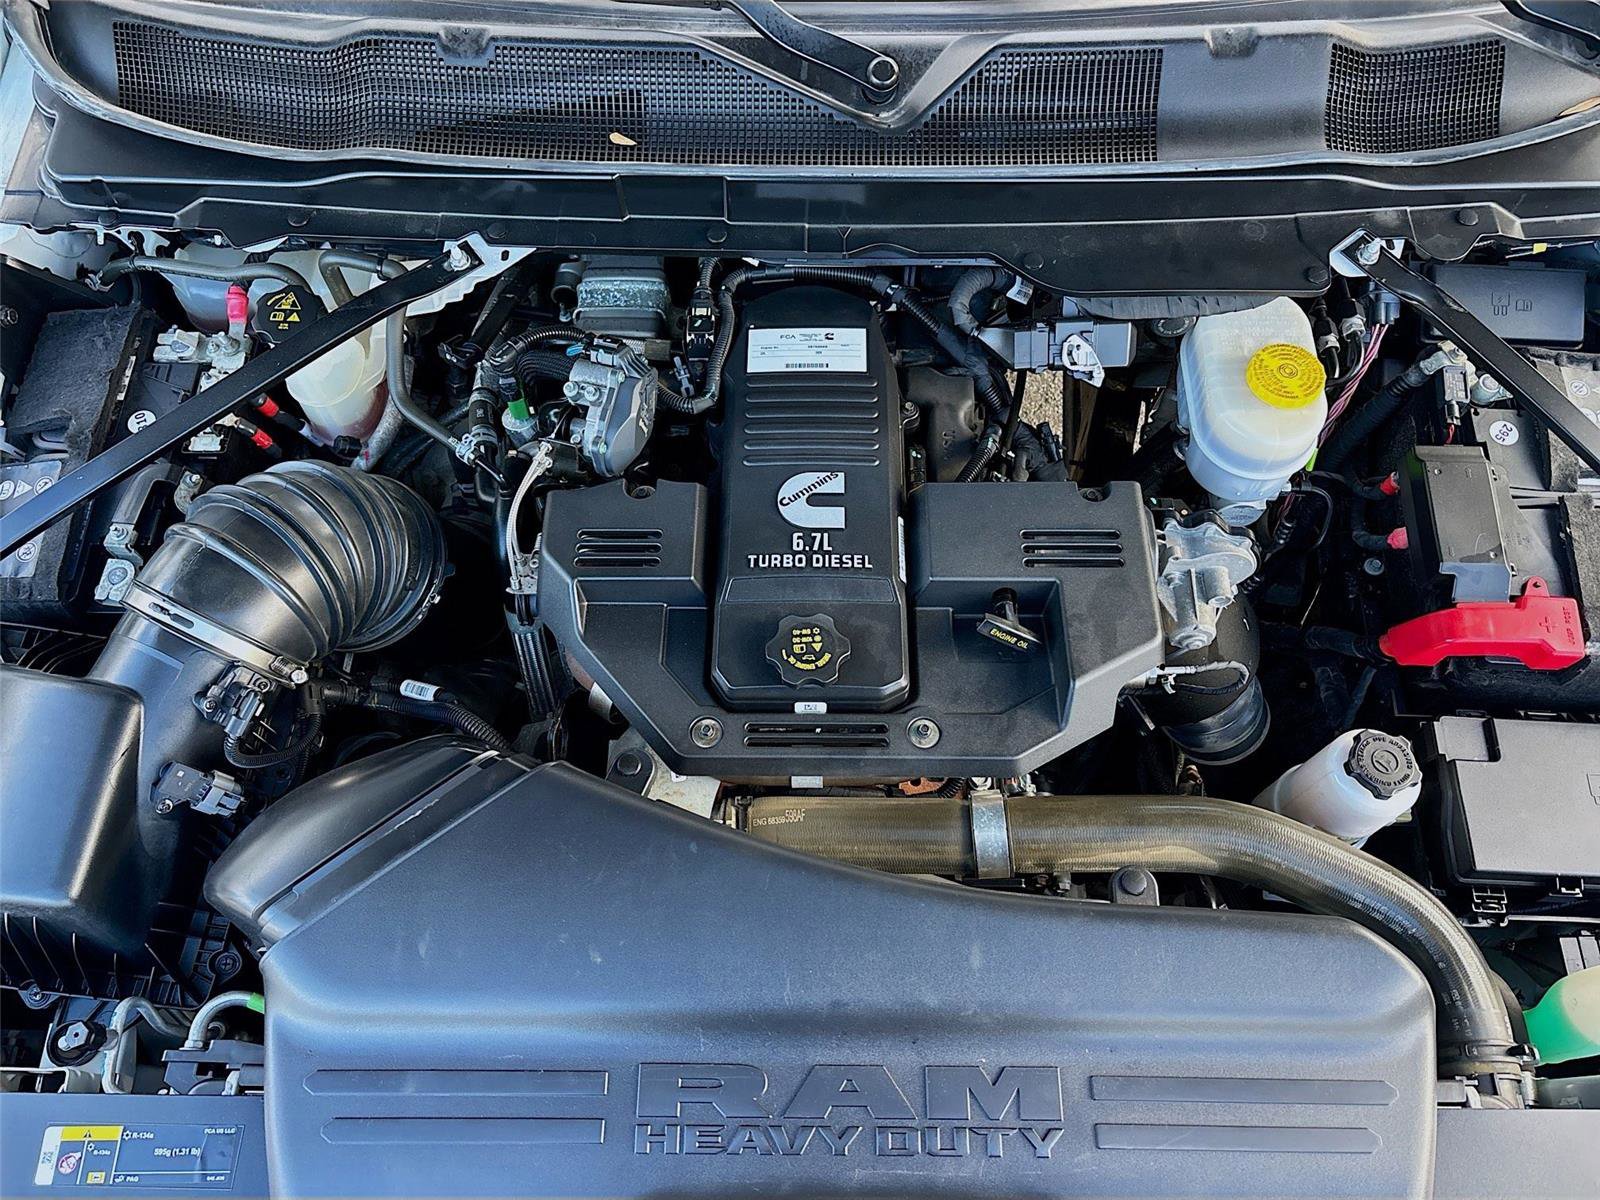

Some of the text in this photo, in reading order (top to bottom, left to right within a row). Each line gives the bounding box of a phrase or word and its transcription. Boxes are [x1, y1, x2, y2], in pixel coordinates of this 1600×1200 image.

[1495, 423, 1513, 442] 295
[779, 472, 839, 507] Cummins
[792, 532, 833, 551] 6.7L
[747, 554, 873, 569] TURBO DIESEL
[990, 628, 1029, 649] ENGINE OIL
[636, 1062, 1064, 1121] RAM
[132, 1132, 154, 1140] R-134a
[634, 1124, 1064, 1159] HEAVY DUTY
[153, 1148, 171, 1158] 595g
[172, 1148, 189, 1158] (1.31
